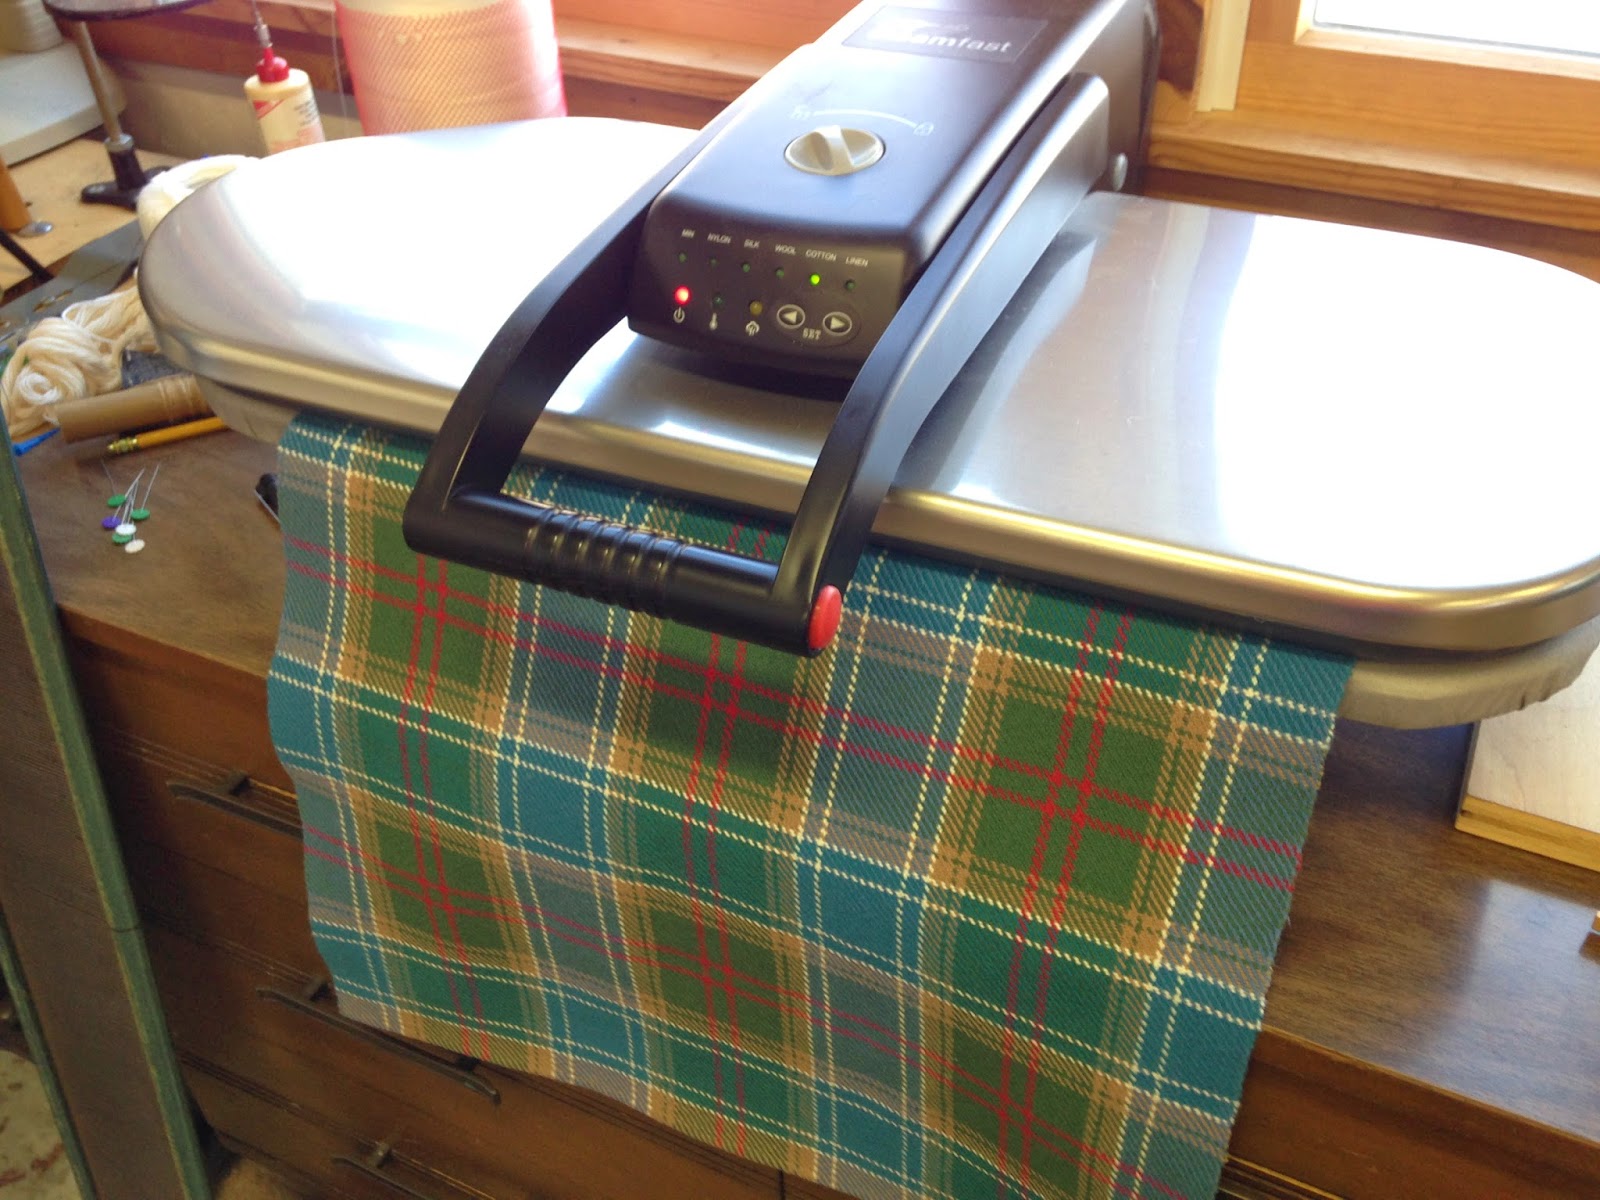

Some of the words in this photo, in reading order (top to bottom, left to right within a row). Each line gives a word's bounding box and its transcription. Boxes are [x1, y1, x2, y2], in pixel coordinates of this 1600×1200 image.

[707, 233, 732, 245] NYLON
[743, 239, 760, 249] SILK
[775, 244, 796, 256] WOOL
[805, 249, 837, 262] COTTON
[845, 256, 869, 268] LINEN
[802, 327, 821, 340] SET
